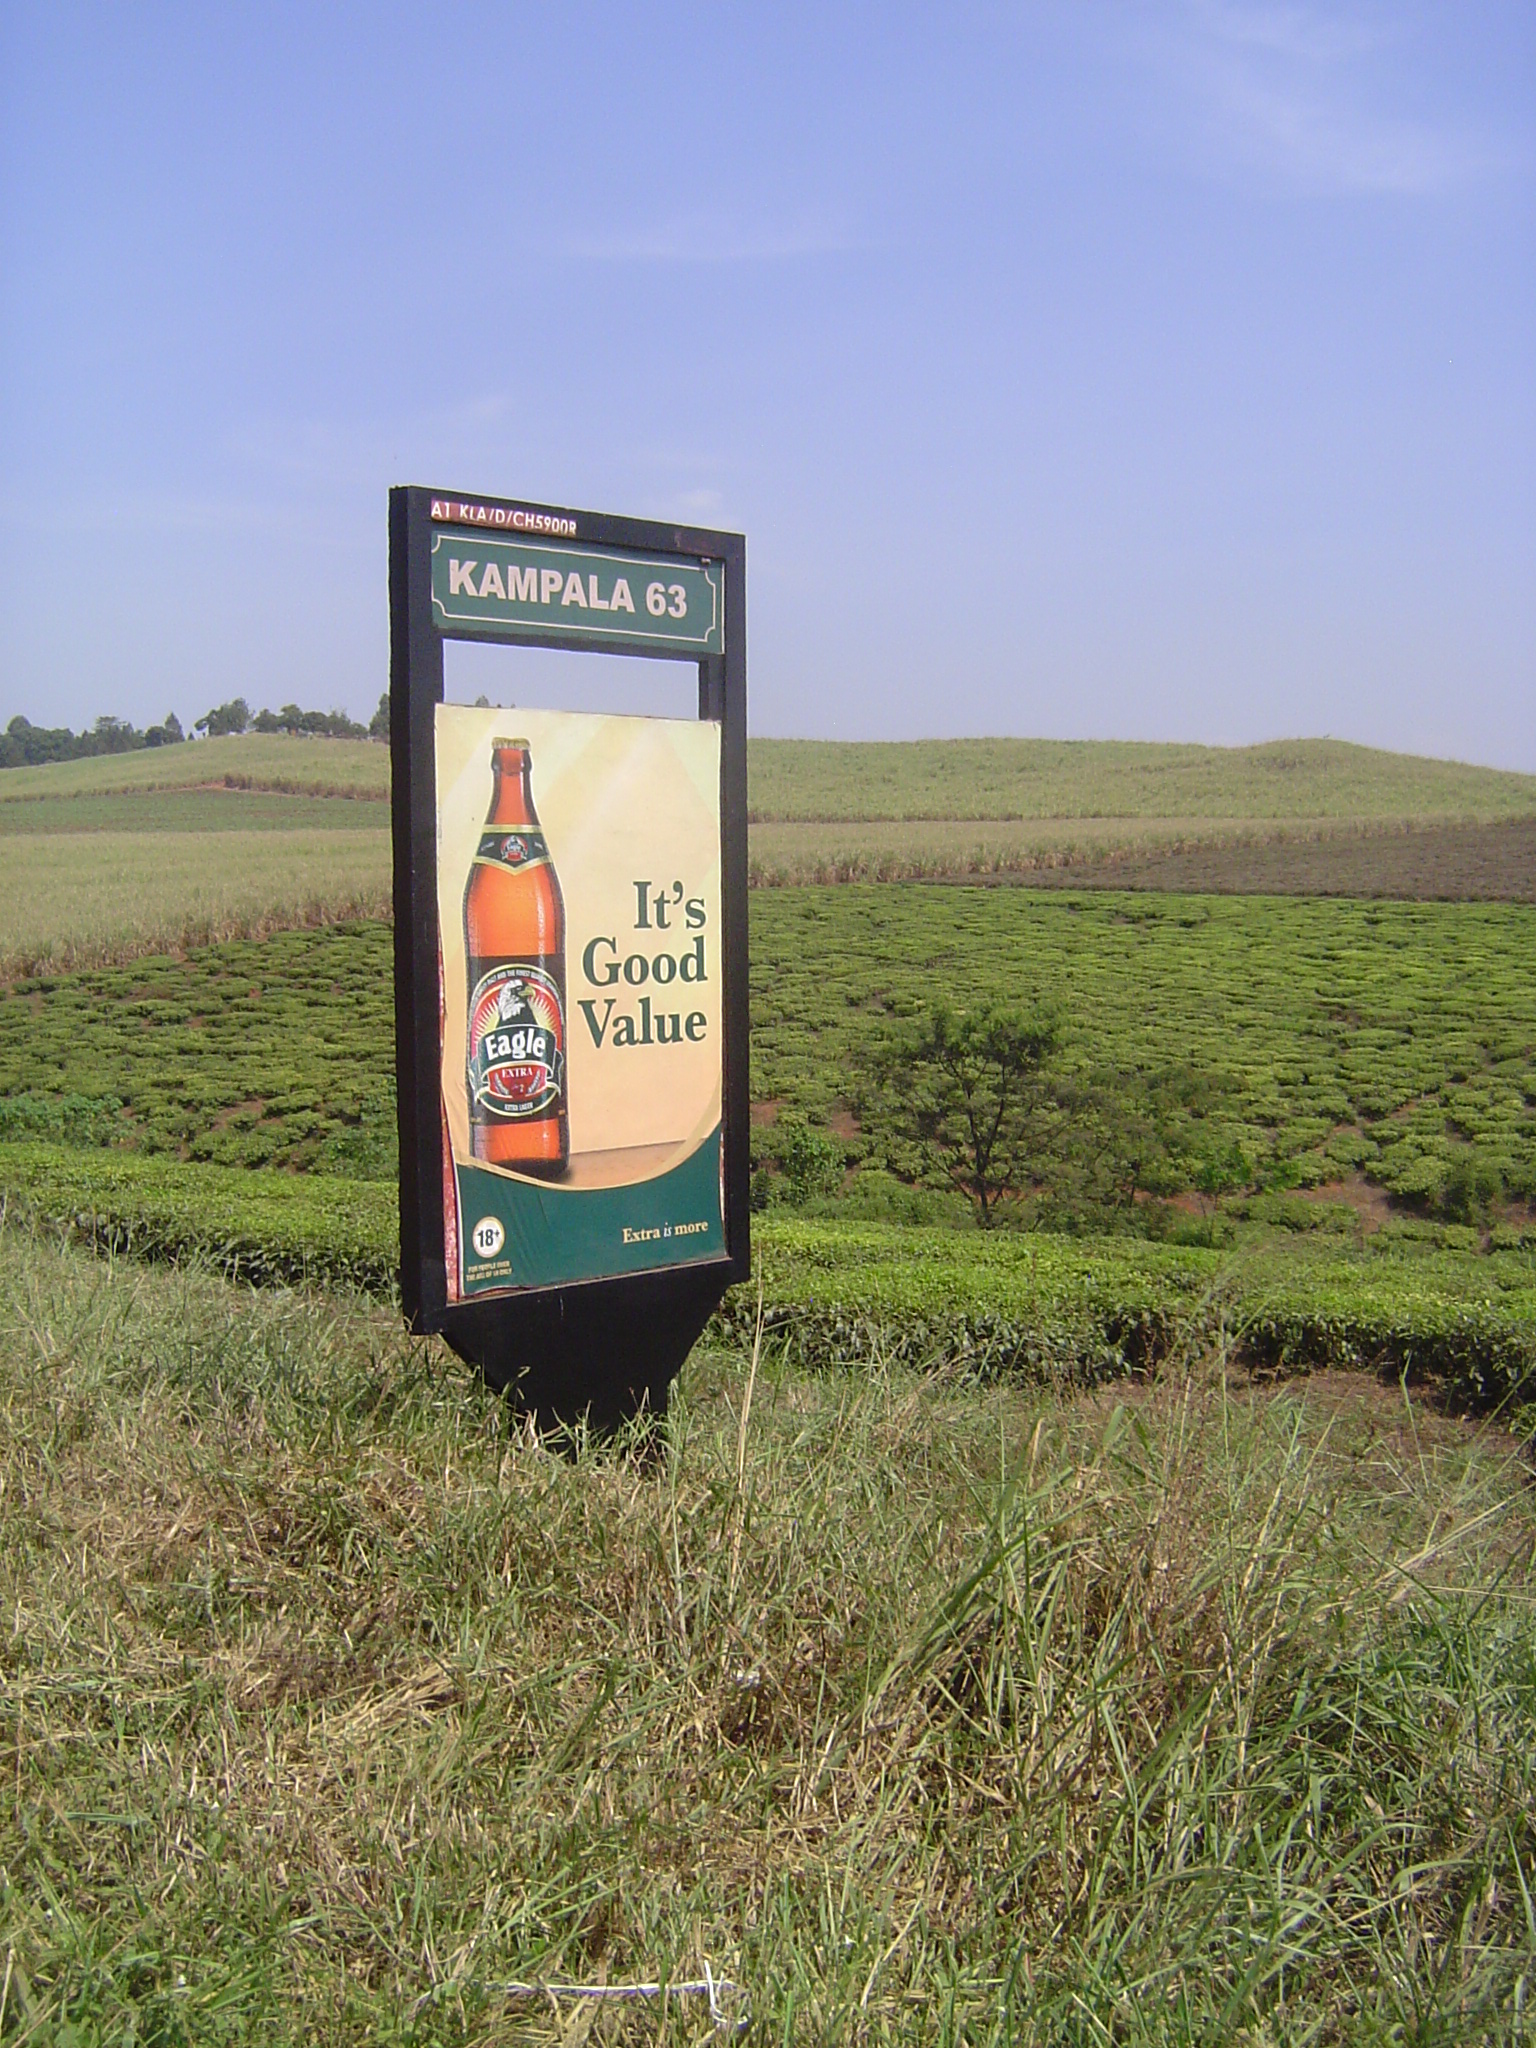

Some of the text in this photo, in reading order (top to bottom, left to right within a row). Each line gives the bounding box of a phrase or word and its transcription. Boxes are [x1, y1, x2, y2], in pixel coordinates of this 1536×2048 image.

[431, 501, 450, 518] A1
[449, 559, 688, 618] KAMPALA 63
[633, 880, 707, 930] It's
[582, 934, 708, 987] Good
[577, 996, 707, 1049] Value
[485, 1028, 546, 1061] Eagle
[501, 1067, 533, 1078] EXTRA
[477, 1228, 500, 1248] 18+
[622, 1221, 709, 1244] Extra is more
